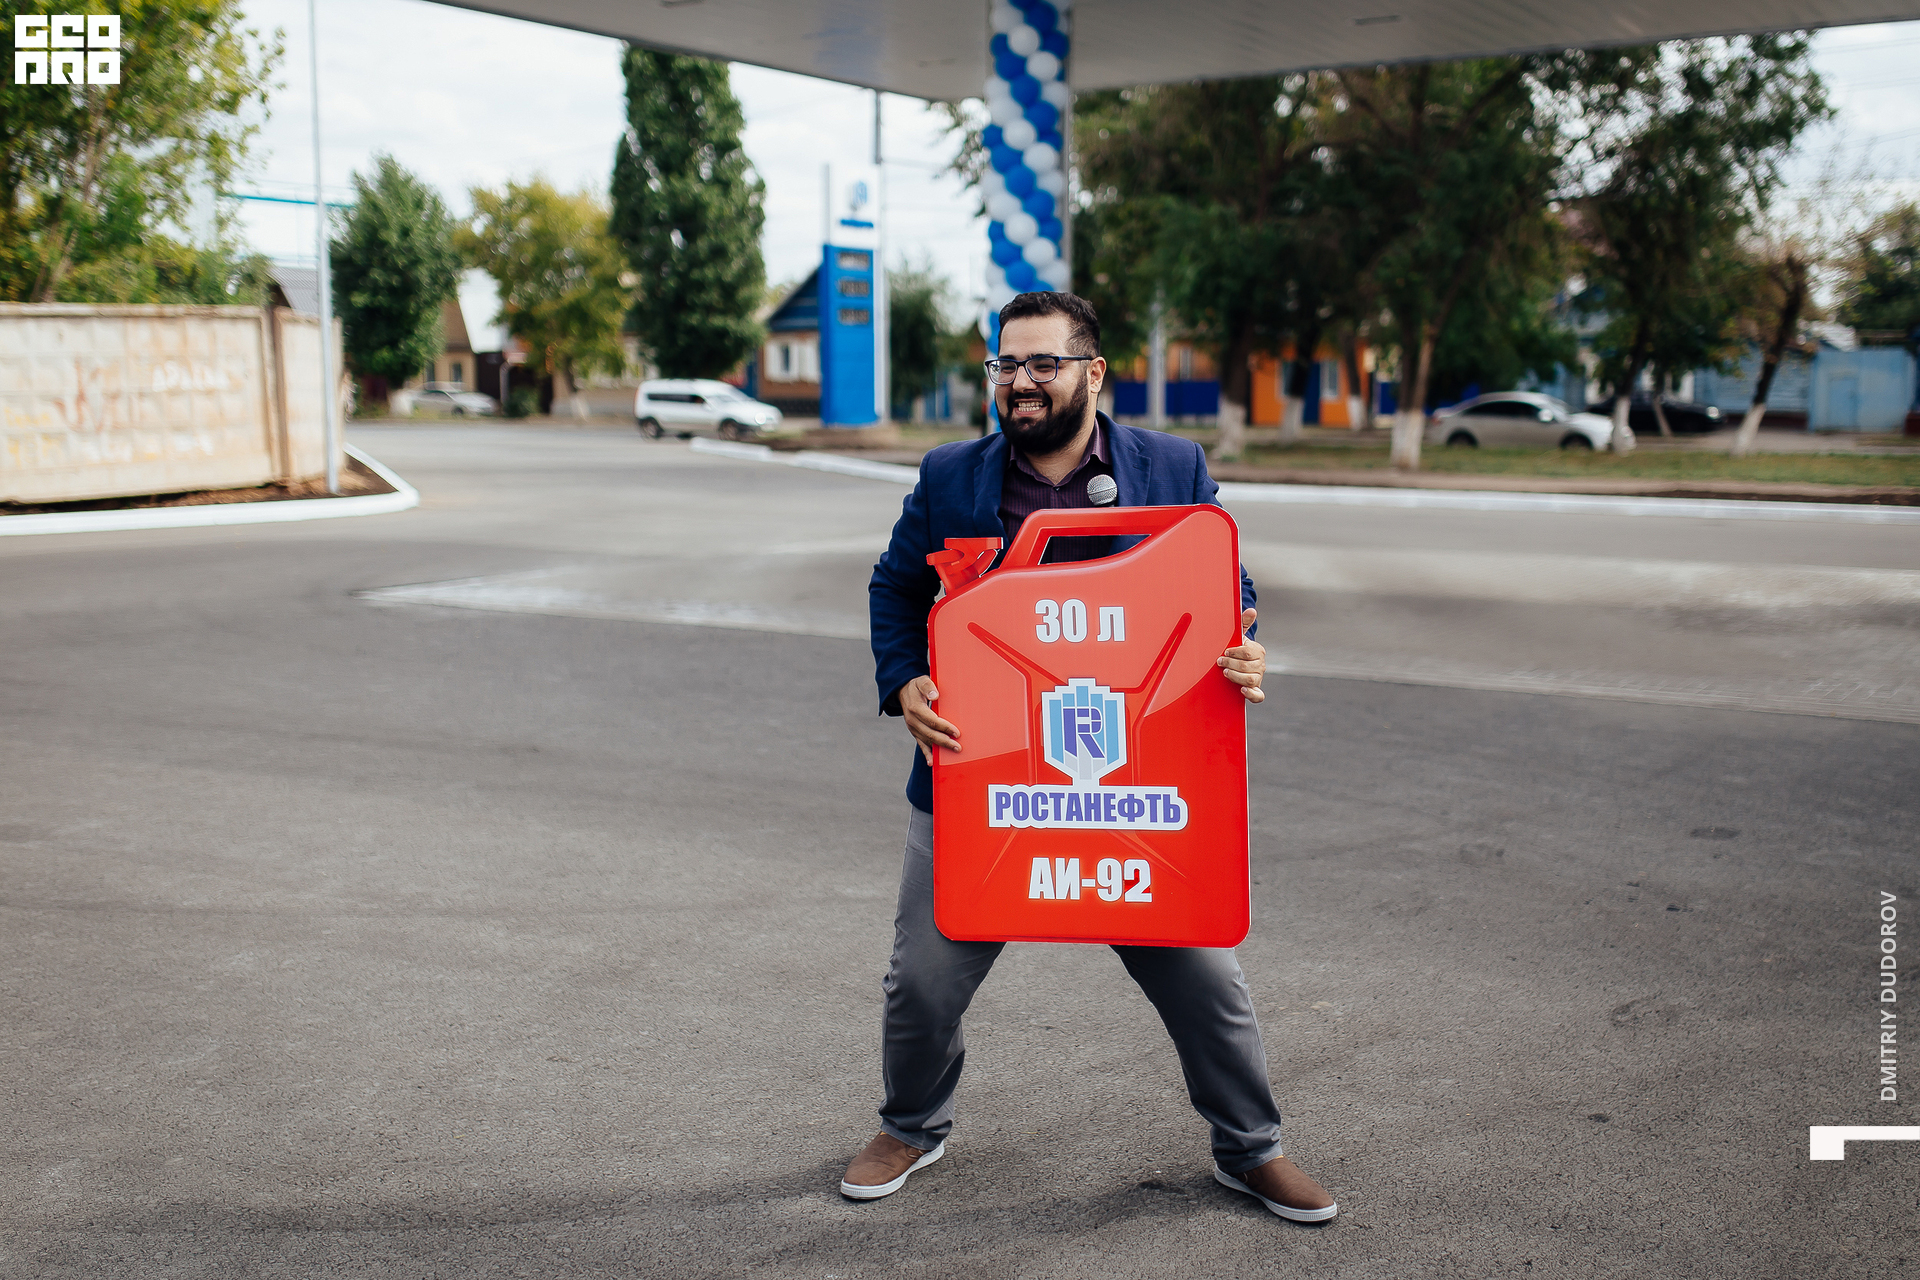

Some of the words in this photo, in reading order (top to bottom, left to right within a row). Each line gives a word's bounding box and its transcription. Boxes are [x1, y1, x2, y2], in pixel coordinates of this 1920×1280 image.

[1035, 598, 1088, 643] 30
[1097, 606, 1126, 642] л
[995, 791, 1182, 824] РОСТАНЕФТЬ
[1028, 857, 1153, 903] АИ-92
